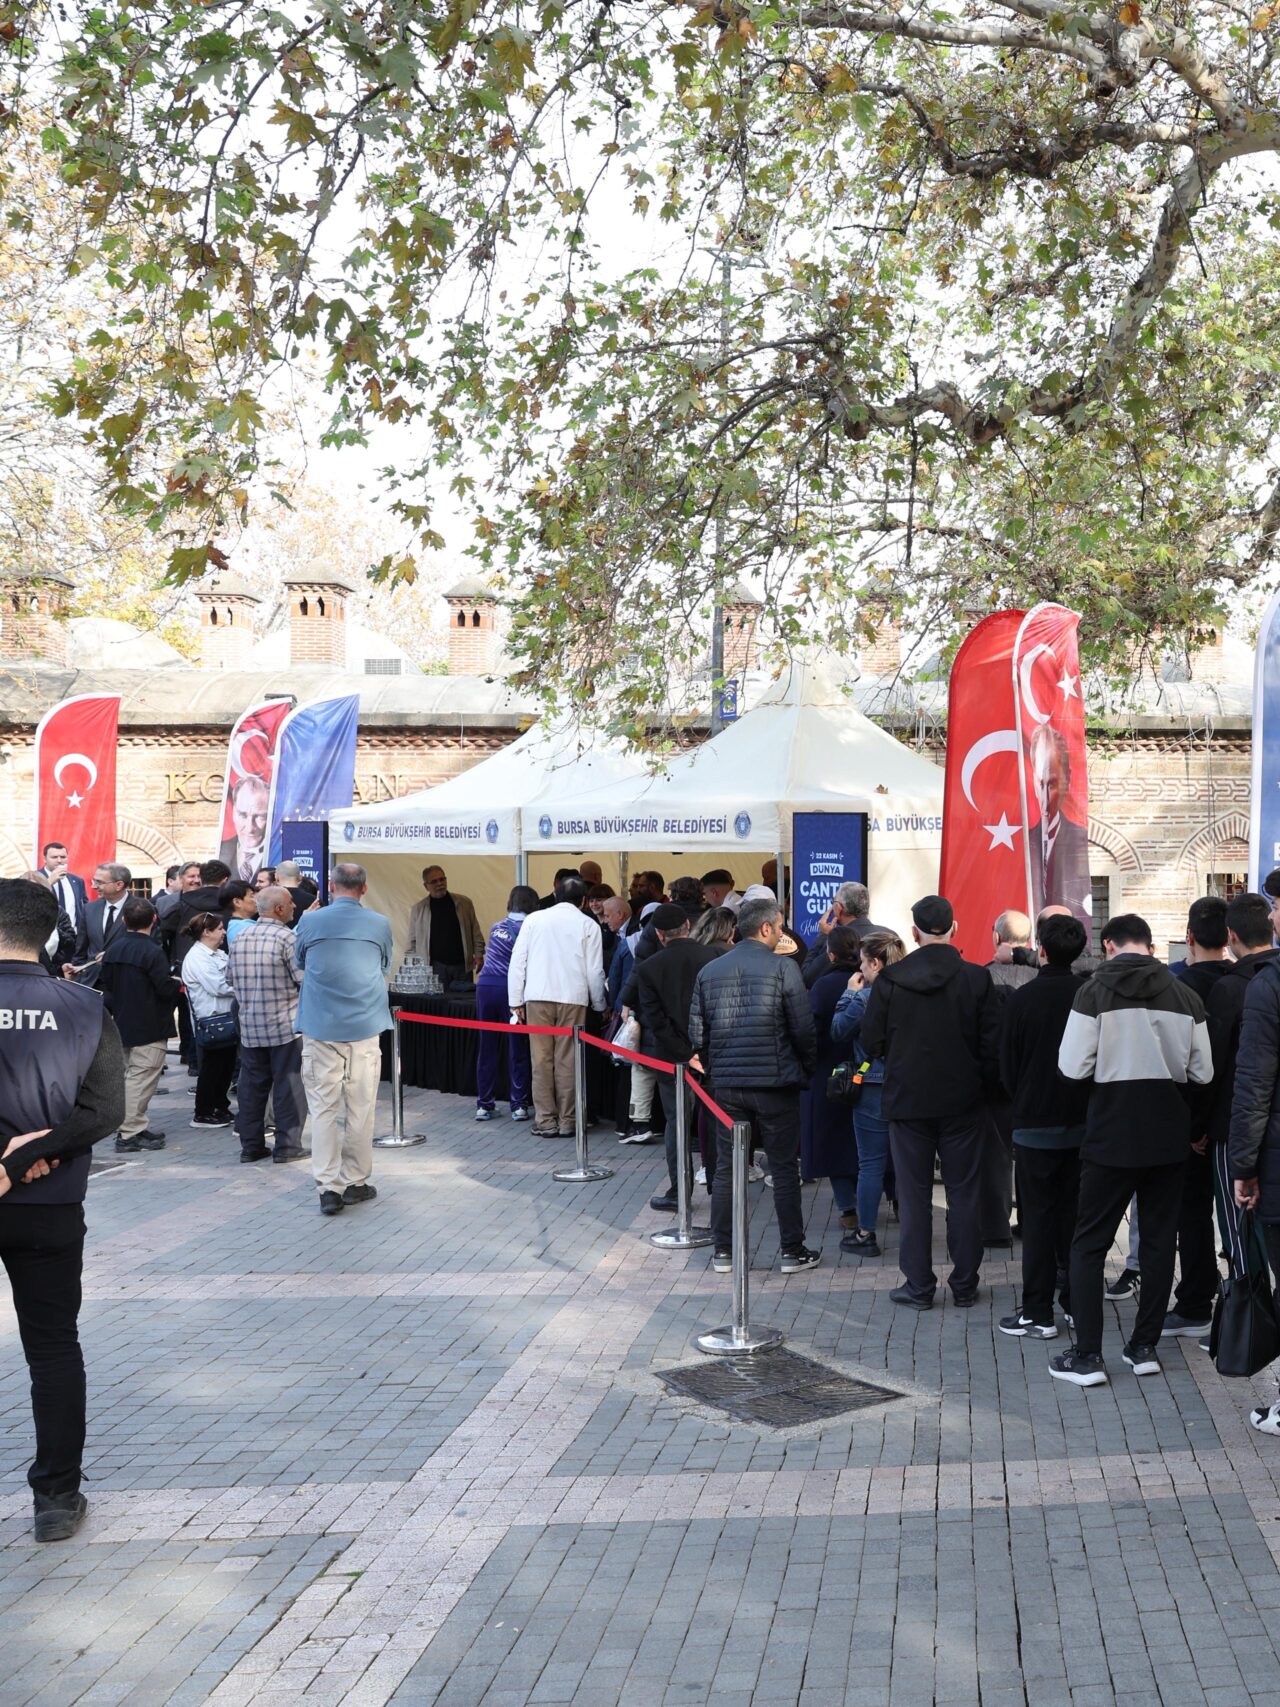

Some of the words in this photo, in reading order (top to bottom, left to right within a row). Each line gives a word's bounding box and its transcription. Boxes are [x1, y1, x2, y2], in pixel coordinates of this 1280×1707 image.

[165, 772, 224, 803] KO
[358, 826, 382, 838] BURSA
[385, 822, 431, 840] BÜYÜKŞEHİR
[435, 822, 481, 839] BELEDİYESİ
[557, 820, 590, 834] BURSA
[594, 815, 658, 836] BÜYÜKŞEHİR
[663, 814, 727, 834] BELEDİYESİ
[886, 813, 943, 834] BÜYÜKŞE
[800, 881, 842, 897] CANT
[0, 1009, 58, 1030] BITA
